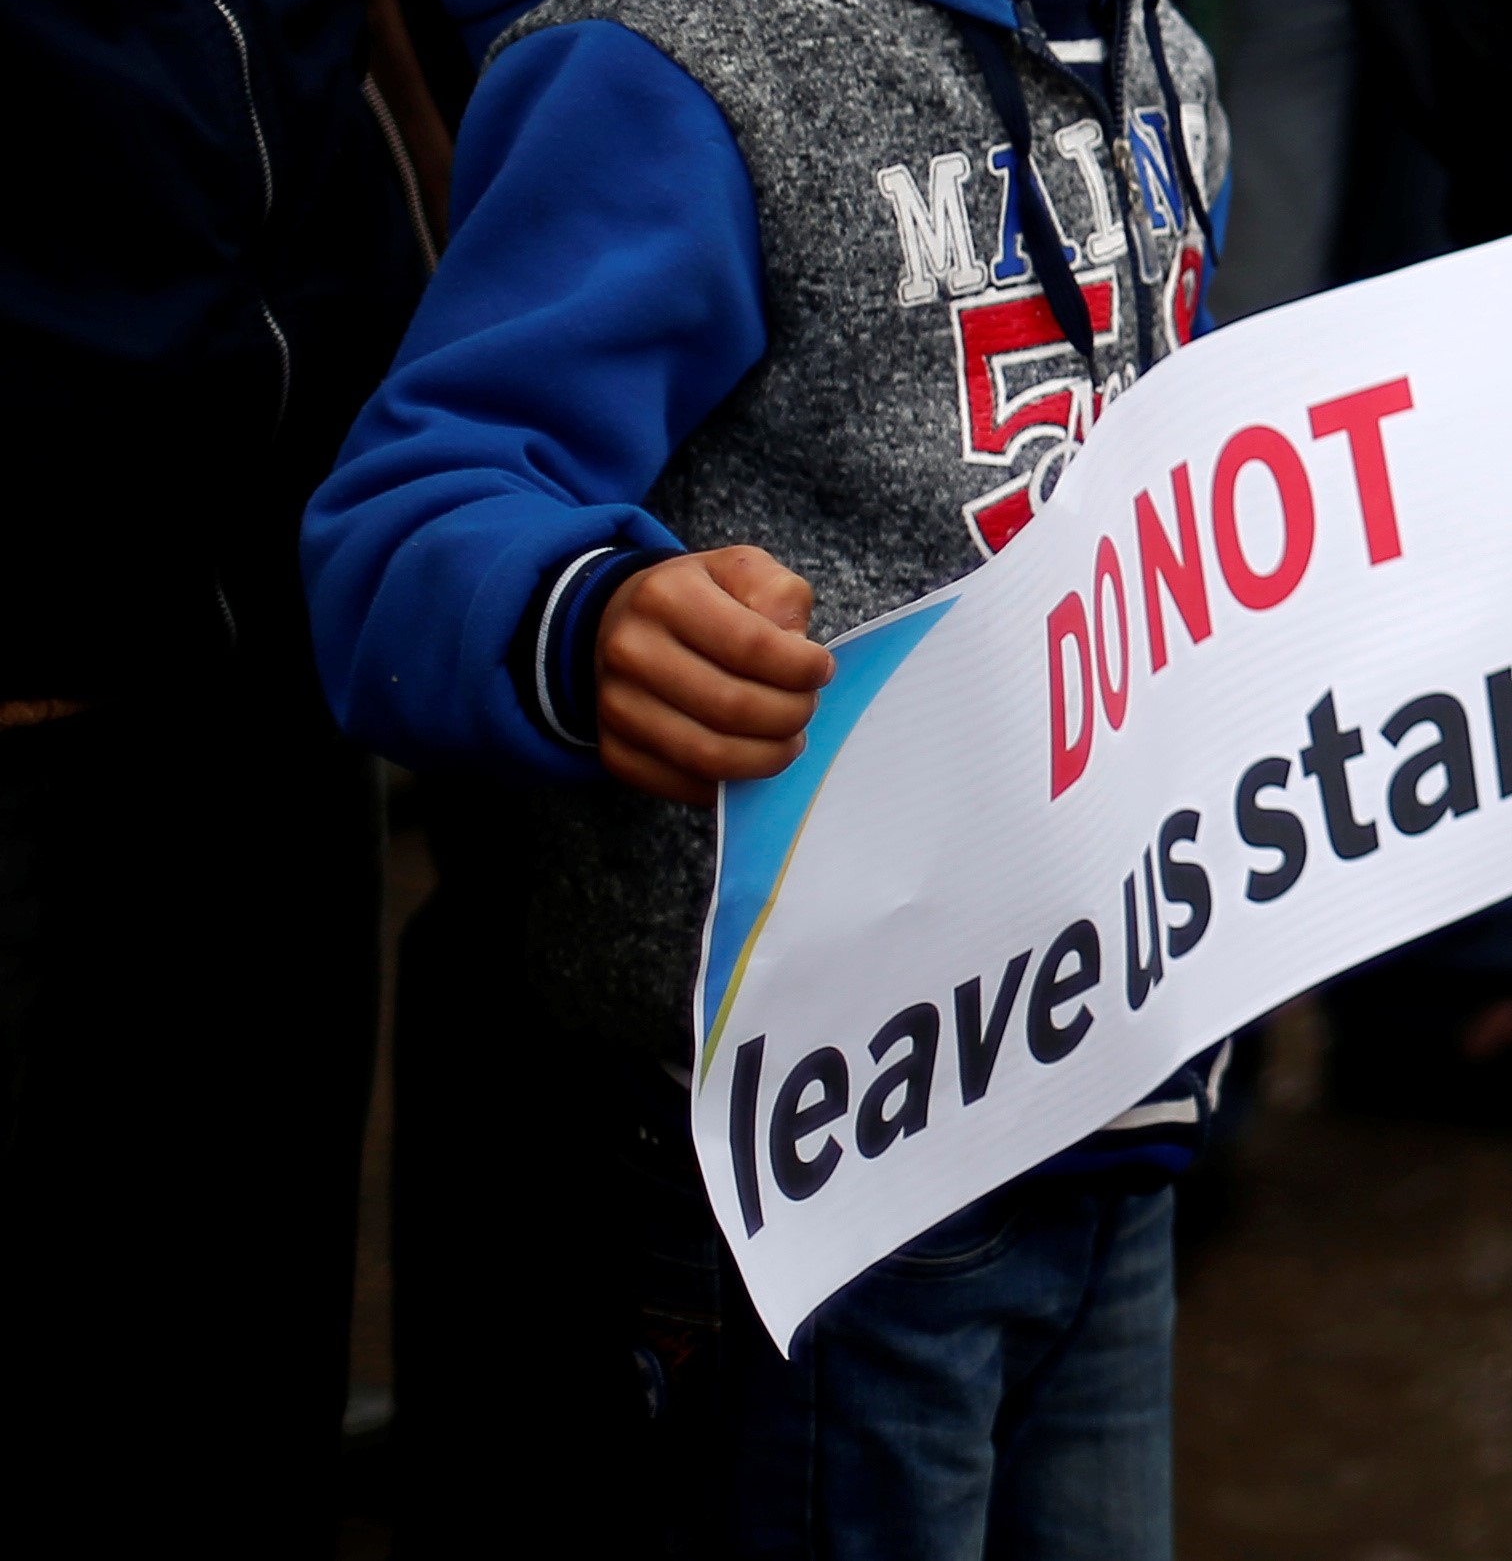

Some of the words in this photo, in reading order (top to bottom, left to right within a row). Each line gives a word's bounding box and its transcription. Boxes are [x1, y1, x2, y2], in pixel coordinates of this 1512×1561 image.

[1044, 533, 1134, 802] DO
[1135, 374, 1414, 673] NOT
[728, 916, 1102, 1239] leave
[1122, 808, 1214, 1013] us
